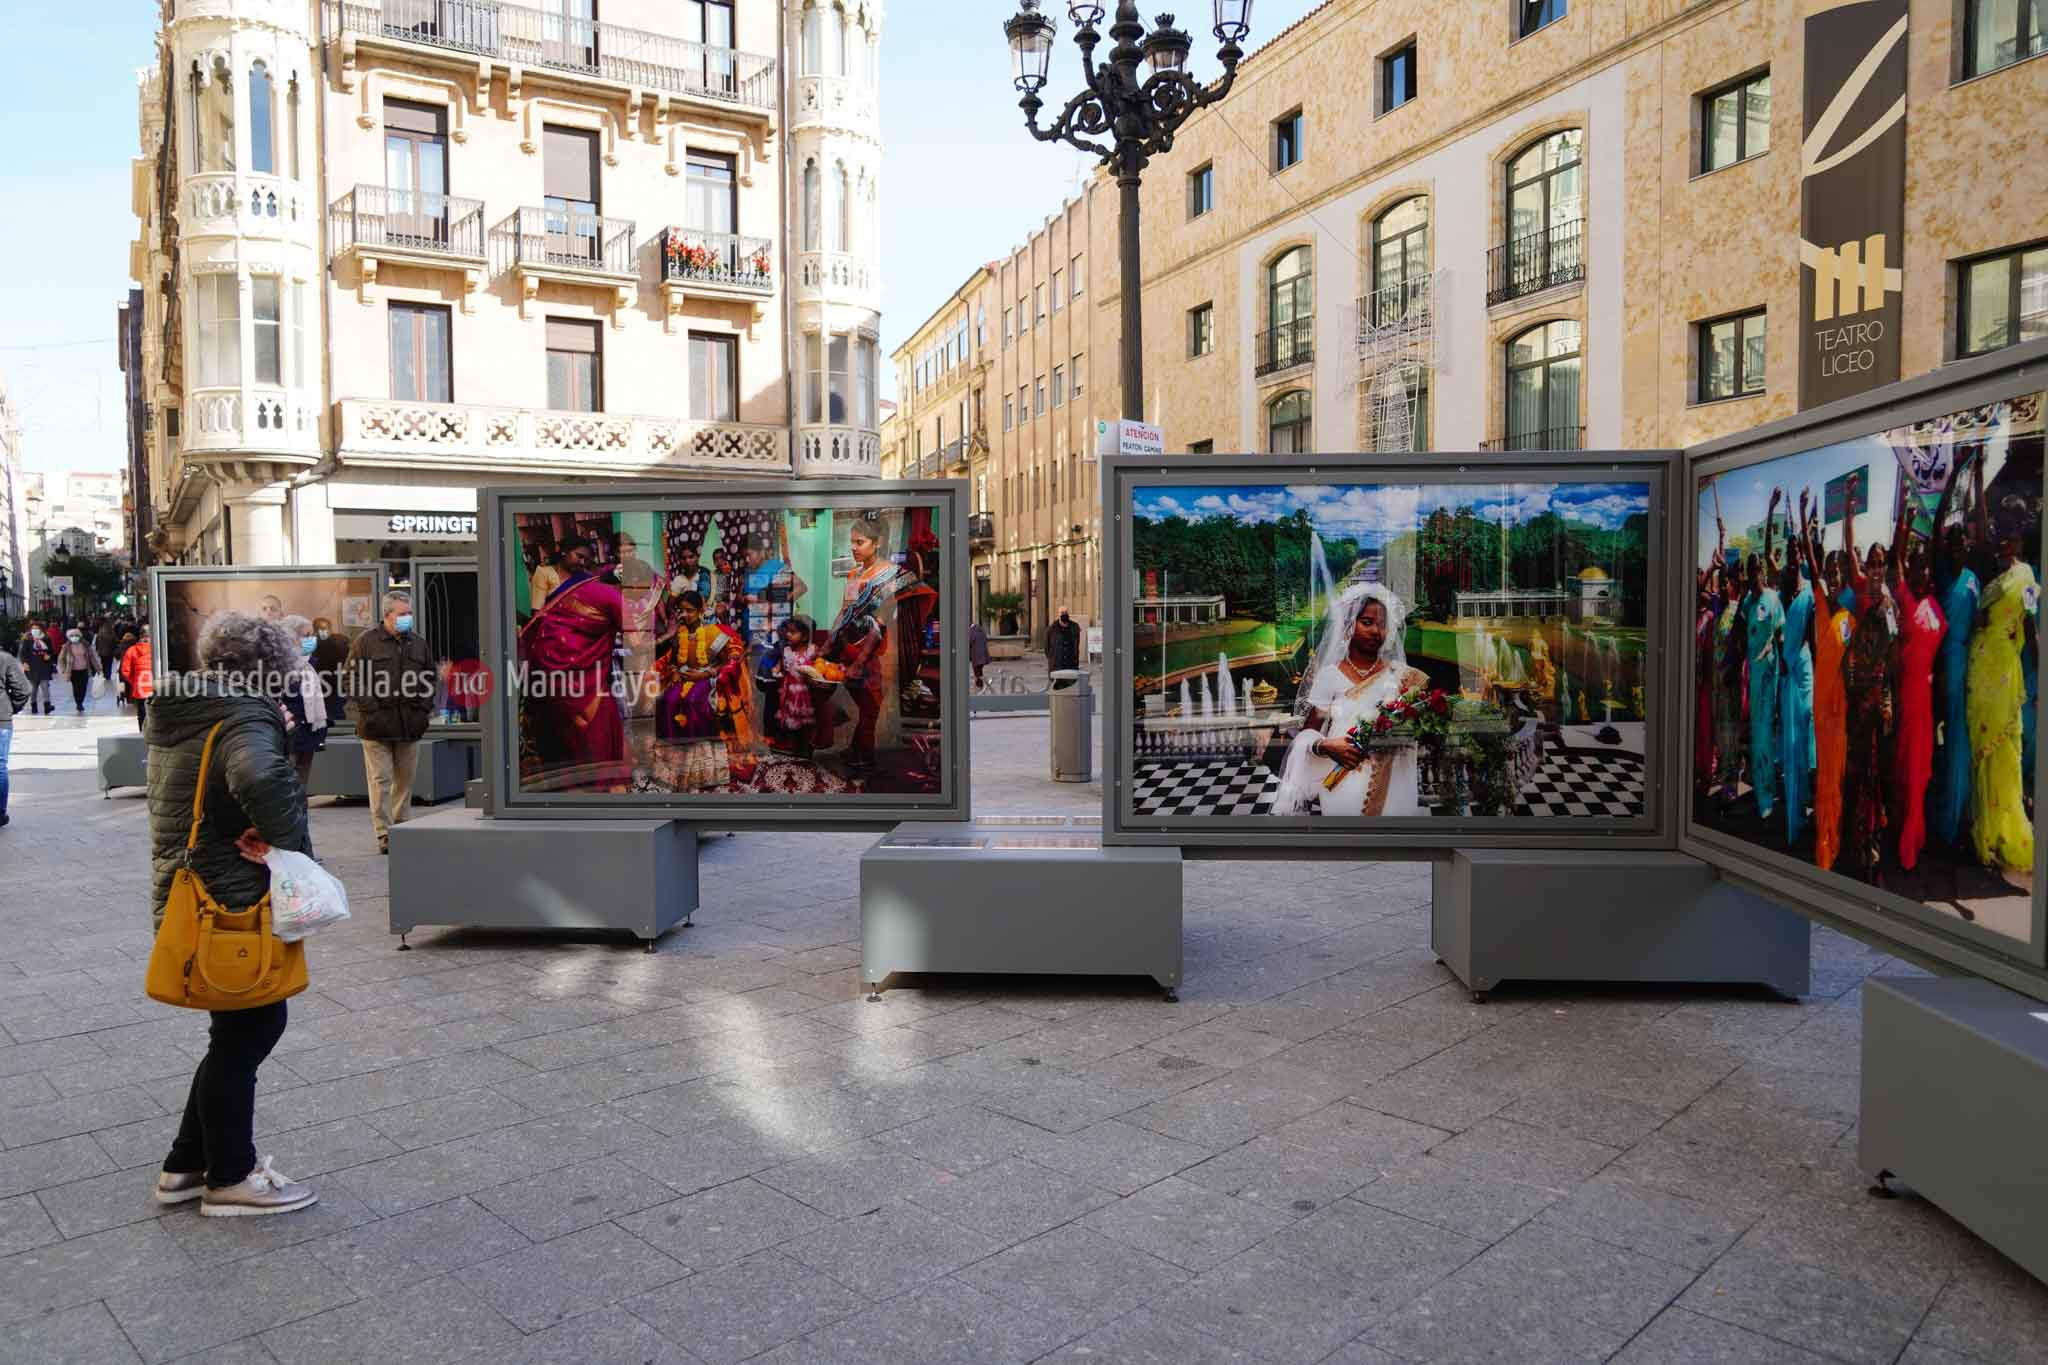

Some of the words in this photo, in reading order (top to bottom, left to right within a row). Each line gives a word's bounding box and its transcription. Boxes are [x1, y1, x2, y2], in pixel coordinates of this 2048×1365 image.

[1815, 320, 1884, 352] TEATRO
[1822, 349, 1875, 377] LICEO
[390, 515, 477, 533] SPRINGFI
